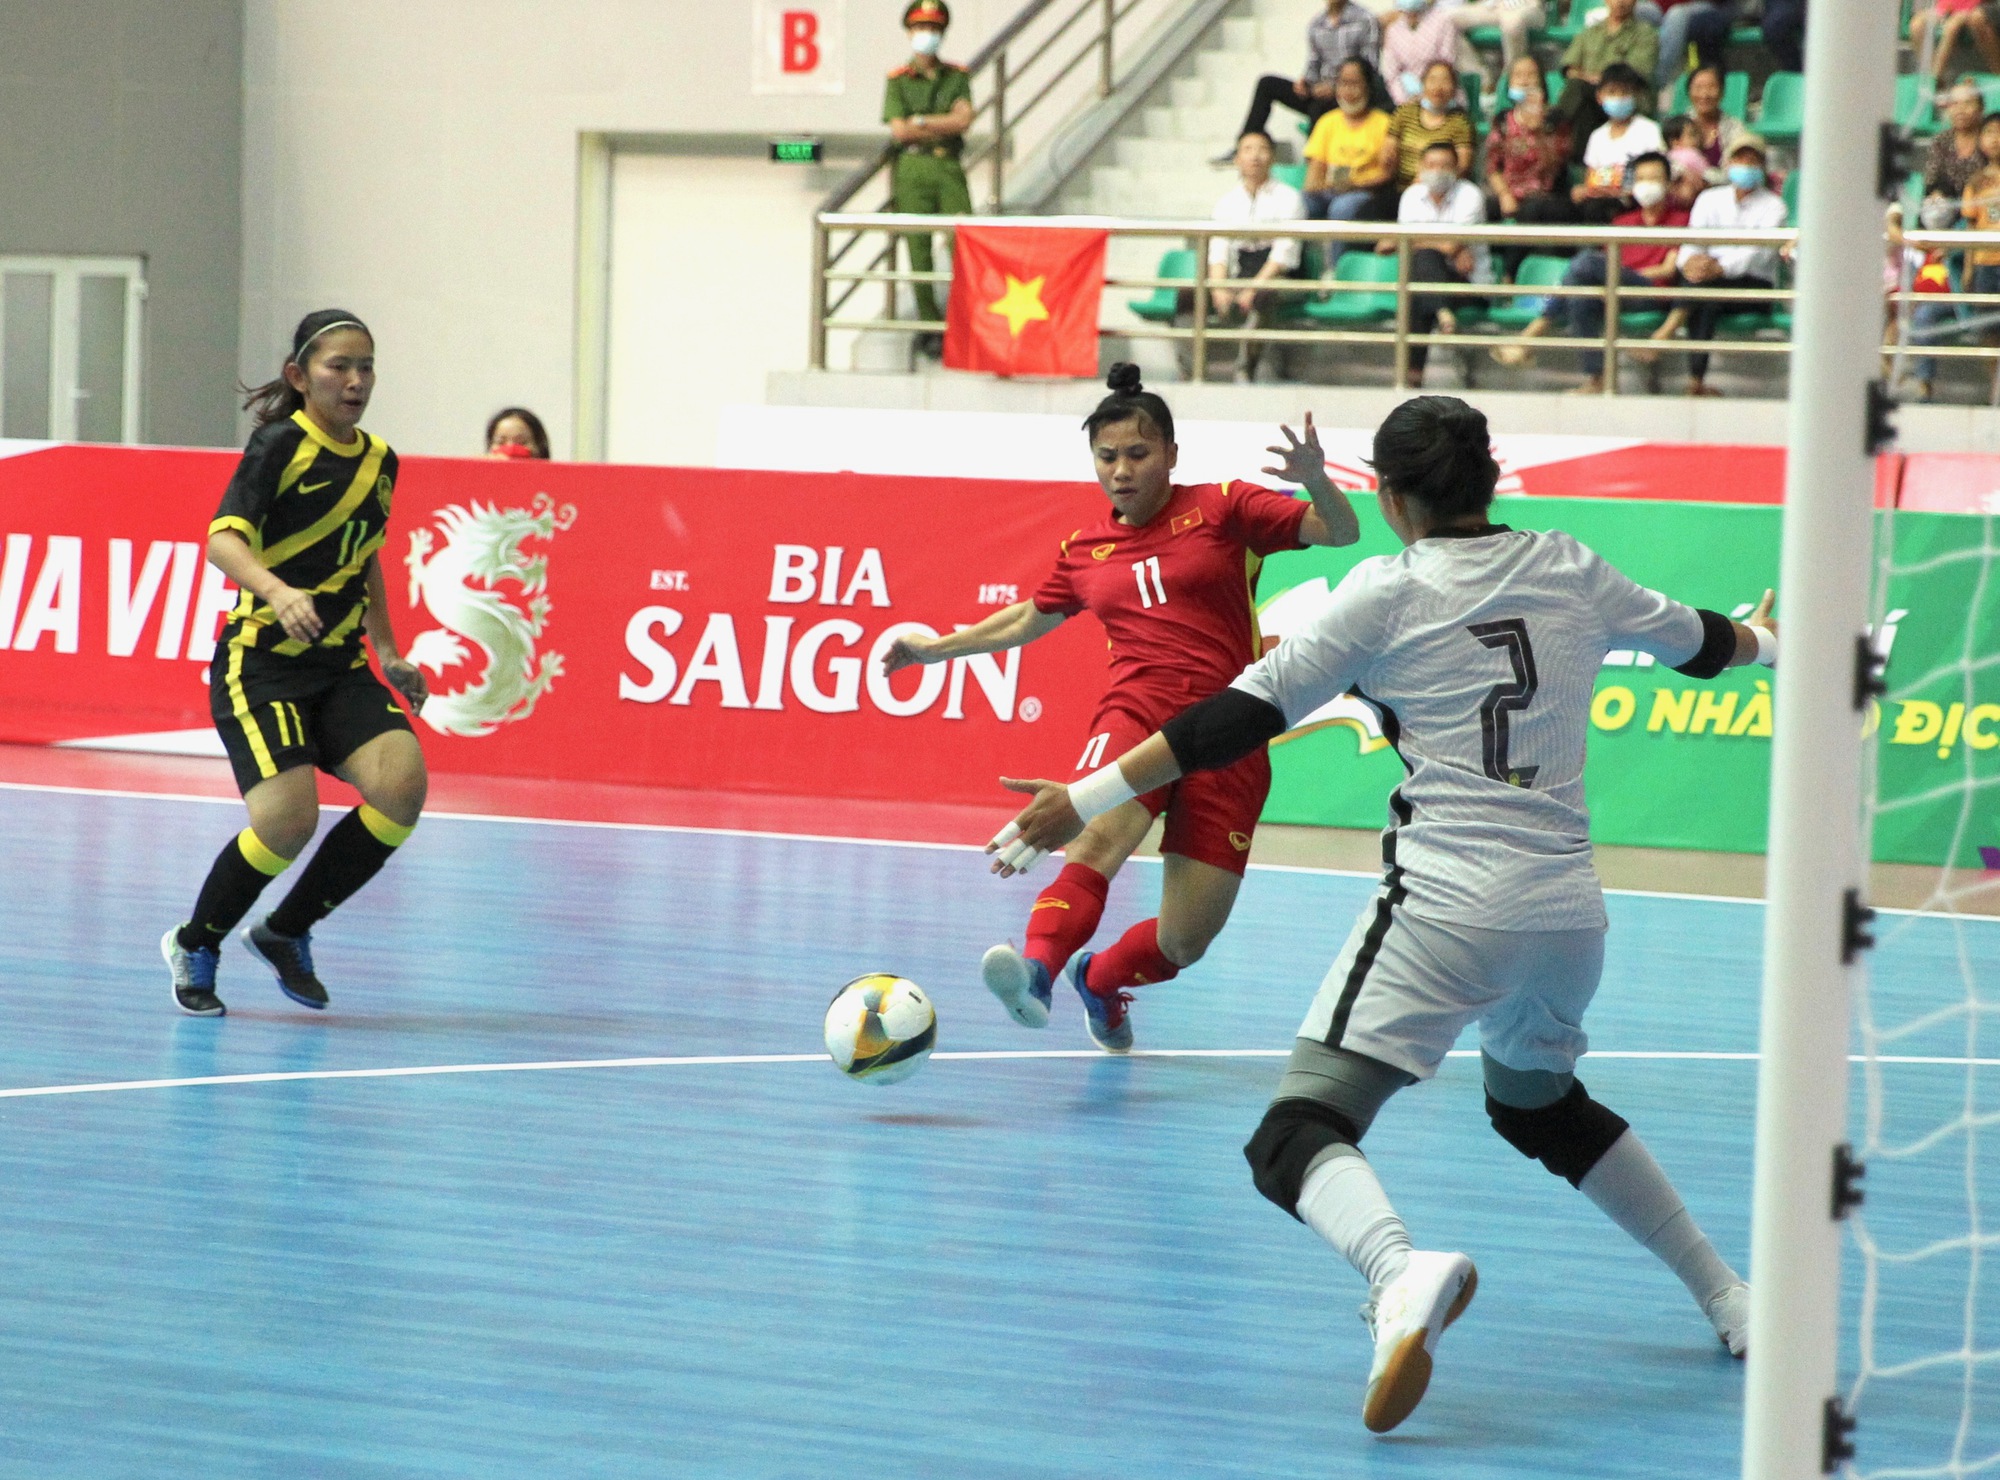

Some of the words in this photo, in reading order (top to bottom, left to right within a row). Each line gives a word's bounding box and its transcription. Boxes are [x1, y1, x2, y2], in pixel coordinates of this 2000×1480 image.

[782, 11, 819, 73] B
[337, 520, 368, 566] 11
[650, 570, 690, 591] EST.
[767, 544, 890, 607] BIA
[977, 583, 1019, 605] 1875
[1131, 556, 1168, 609] 11
[618, 605, 1023, 722] SAIGON
[270, 701, 306, 747] 11
[1466, 617, 1540, 790] 2
[1646, 679, 1774, 737] NHÀ
[1075, 731, 1111, 771] 11
